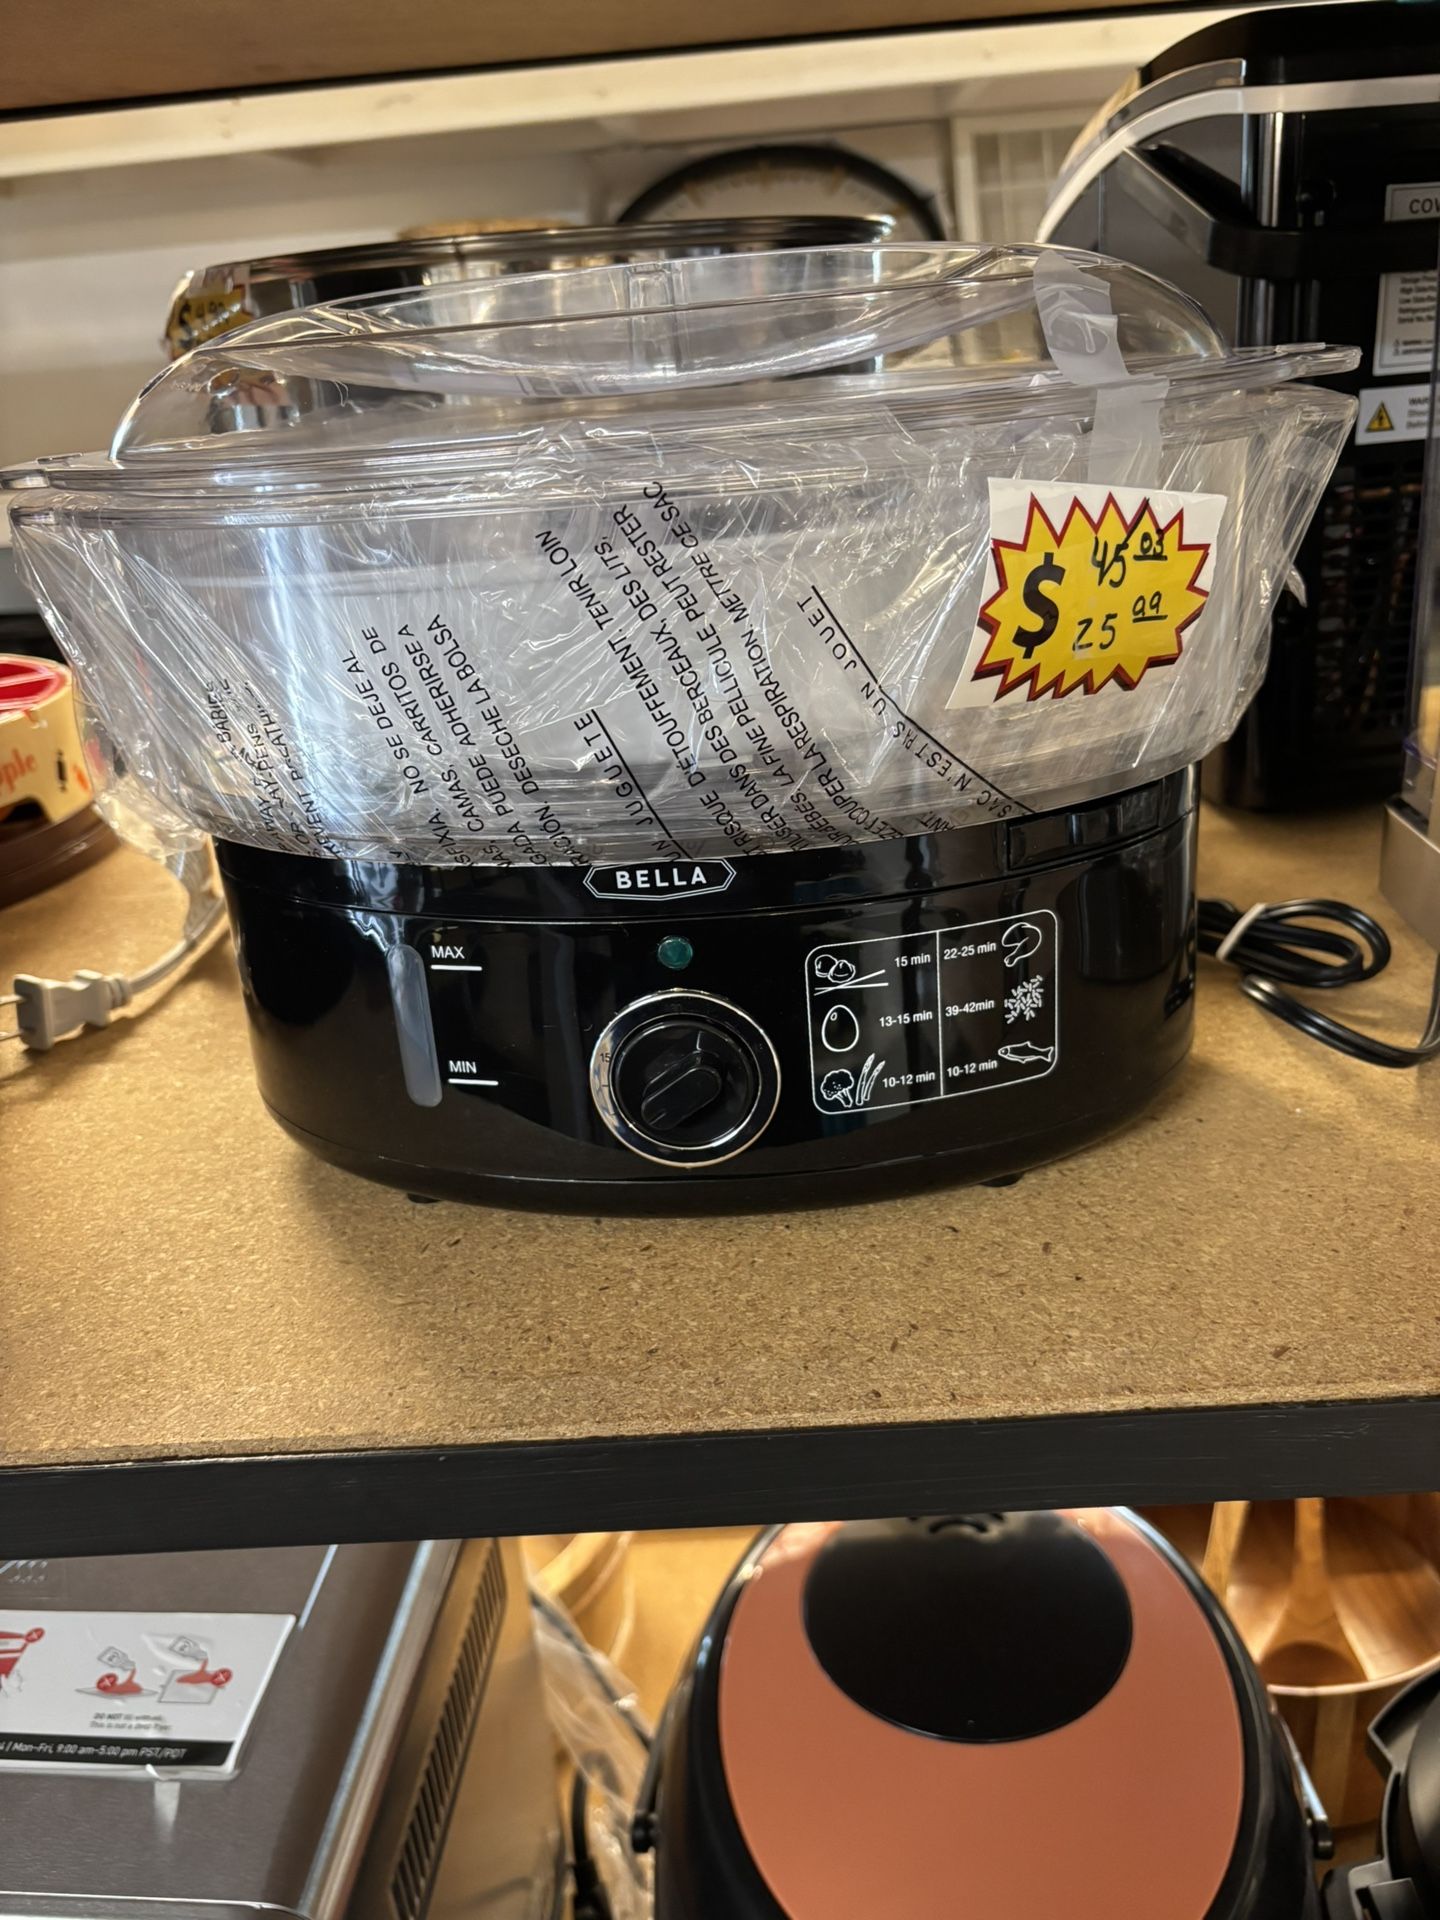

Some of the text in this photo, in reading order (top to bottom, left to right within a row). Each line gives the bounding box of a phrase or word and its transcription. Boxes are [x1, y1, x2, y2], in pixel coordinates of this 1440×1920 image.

[643, 481, 680, 522] SAC
[535, 530, 578, 577] LOIN
[613, 504, 673, 578] RESTER
[672, 521, 699, 548] CE
[594, 536, 631, 580] LITS,
[568, 573, 614, 631] TENIR
[623, 580, 658, 621] DES
[661, 576, 705, 622] PEUT
[691, 552, 749, 623] METTRE
[1012, 552, 1066, 659] $
[361, 627, 387, 654] DE
[427, 614, 475, 682] BOLSA
[797, 596, 857, 671] JOUET
[1072, 613, 1118, 651] 25
[467, 678, 491, 705] LA
[650, 618, 714, 725] BERCEAUX,
[696, 623, 756, 727] PELLICULE
[741, 624, 812, 750] RESPIRATION.
[382, 662, 443, 756] CARRITOS
[860, 682, 887, 716] UN
[342, 650, 475, 866] SFIXIA. NO SE DEJE AL
[398, 624, 552, 866] GADA PUEDE ADHERIRSE A
[481, 705, 540, 795] DESECHE
[705, 725, 737, 764] DES
[746, 725, 781, 765] FINE
[803, 743, 827, 771] LA
[573, 712, 654, 826] JUGUETE
[729, 764, 770, 810] DANS
[773, 765, 794, 787] LA
[441, 764, 485, 832] CAMAS,
[700, 790, 751, 847] RISQUE
[817, 768, 870, 825] COUPER
[616, 866, 707, 889] BELLA
[431, 945, 465, 959] MAX
[893, 952, 931, 968] 15 min
[943, 941, 997, 960] 22-25 min
[879, 1009, 933, 1028] 13-15 min
[945, 998, 995, 1017] 39-42min
[449, 1060, 477, 1074] MIN
[883, 1070, 936, 1089] 10-12 min
[946, 1058, 998, 1078] 10-12 min
